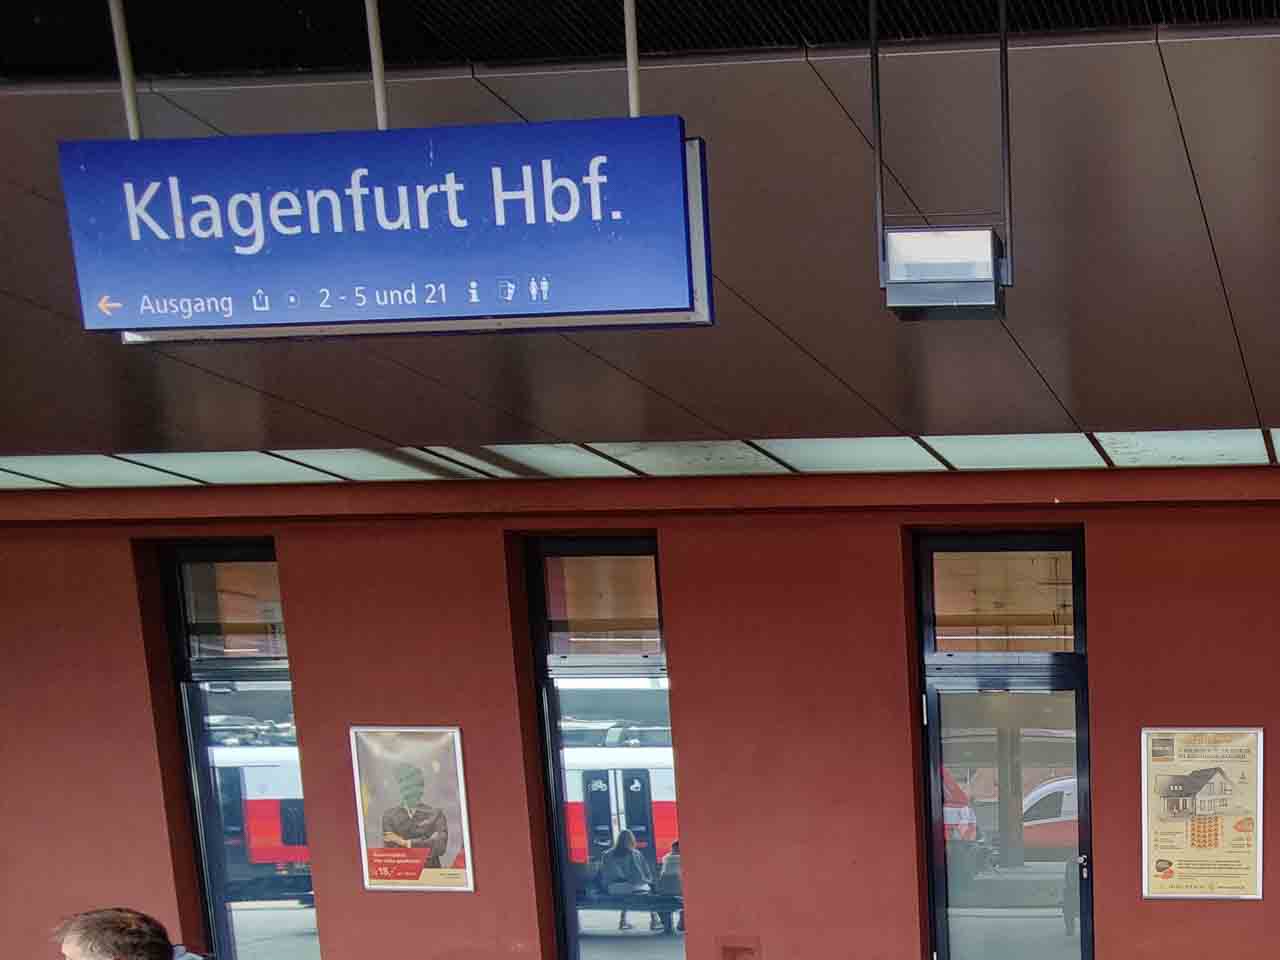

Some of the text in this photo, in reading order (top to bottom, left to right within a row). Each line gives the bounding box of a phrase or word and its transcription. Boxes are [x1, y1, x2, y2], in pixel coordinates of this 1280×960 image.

[123, 155, 624, 255] Klagenfurt Hbf.
[139, 293, 233, 319] Ausgang
[319, 288, 332, 308] 2
[354, 286, 367, 307] 5
[375, 283, 417, 306] und
[424, 283, 447, 305] 21
